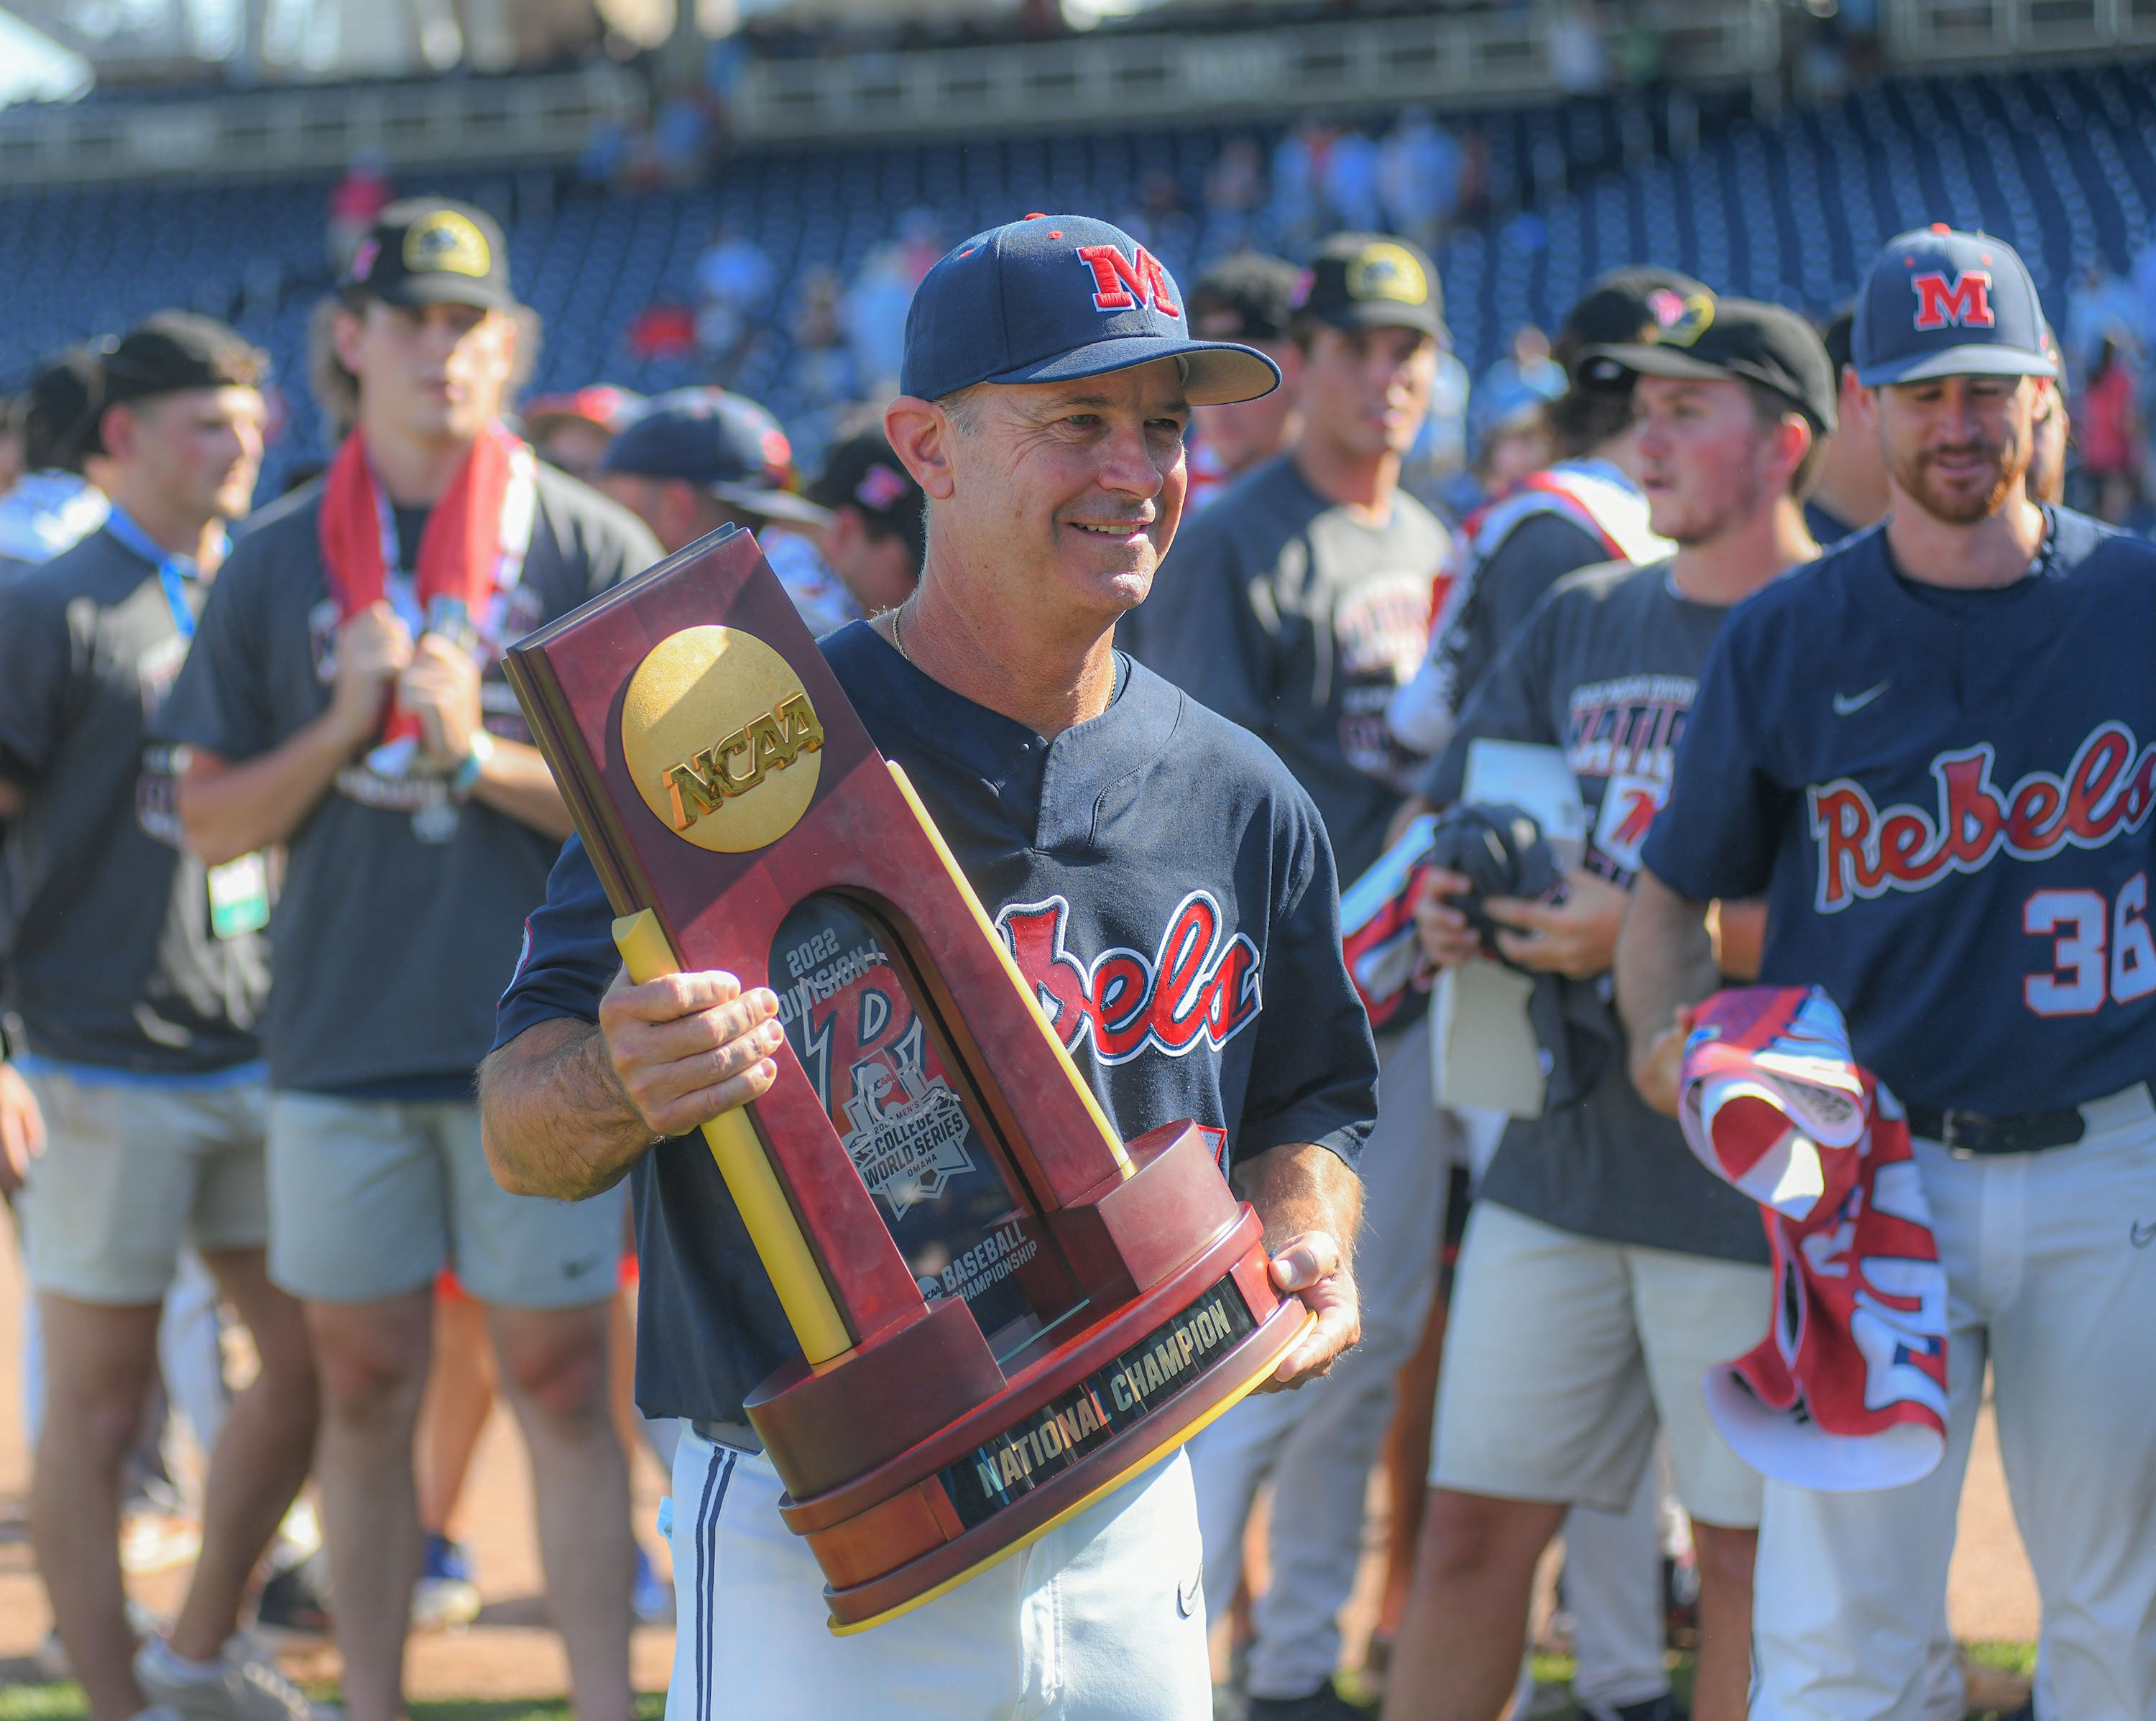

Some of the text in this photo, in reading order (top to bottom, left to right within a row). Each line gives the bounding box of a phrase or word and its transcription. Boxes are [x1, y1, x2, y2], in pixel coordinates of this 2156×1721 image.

[1076, 243, 1179, 320] M
[1910, 269, 1995, 332] M
[662, 691, 824, 831] NCAA
[786, 927, 839, 978] 2022
[2023, 869, 2156, 1018] 36
[778, 946, 870, 1025] DIVISION
[875, 1112, 934, 1157] COLLEGE
[896, 1101, 919, 1120] MEN'S
[863, 1113, 964, 1189] WORLD SERIES
[907, 1154, 937, 1177] OMAHA
[941, 1221, 1027, 1292] BASEBALL
[977, 1299, 1231, 1499] NATIONAL CHAMPION
